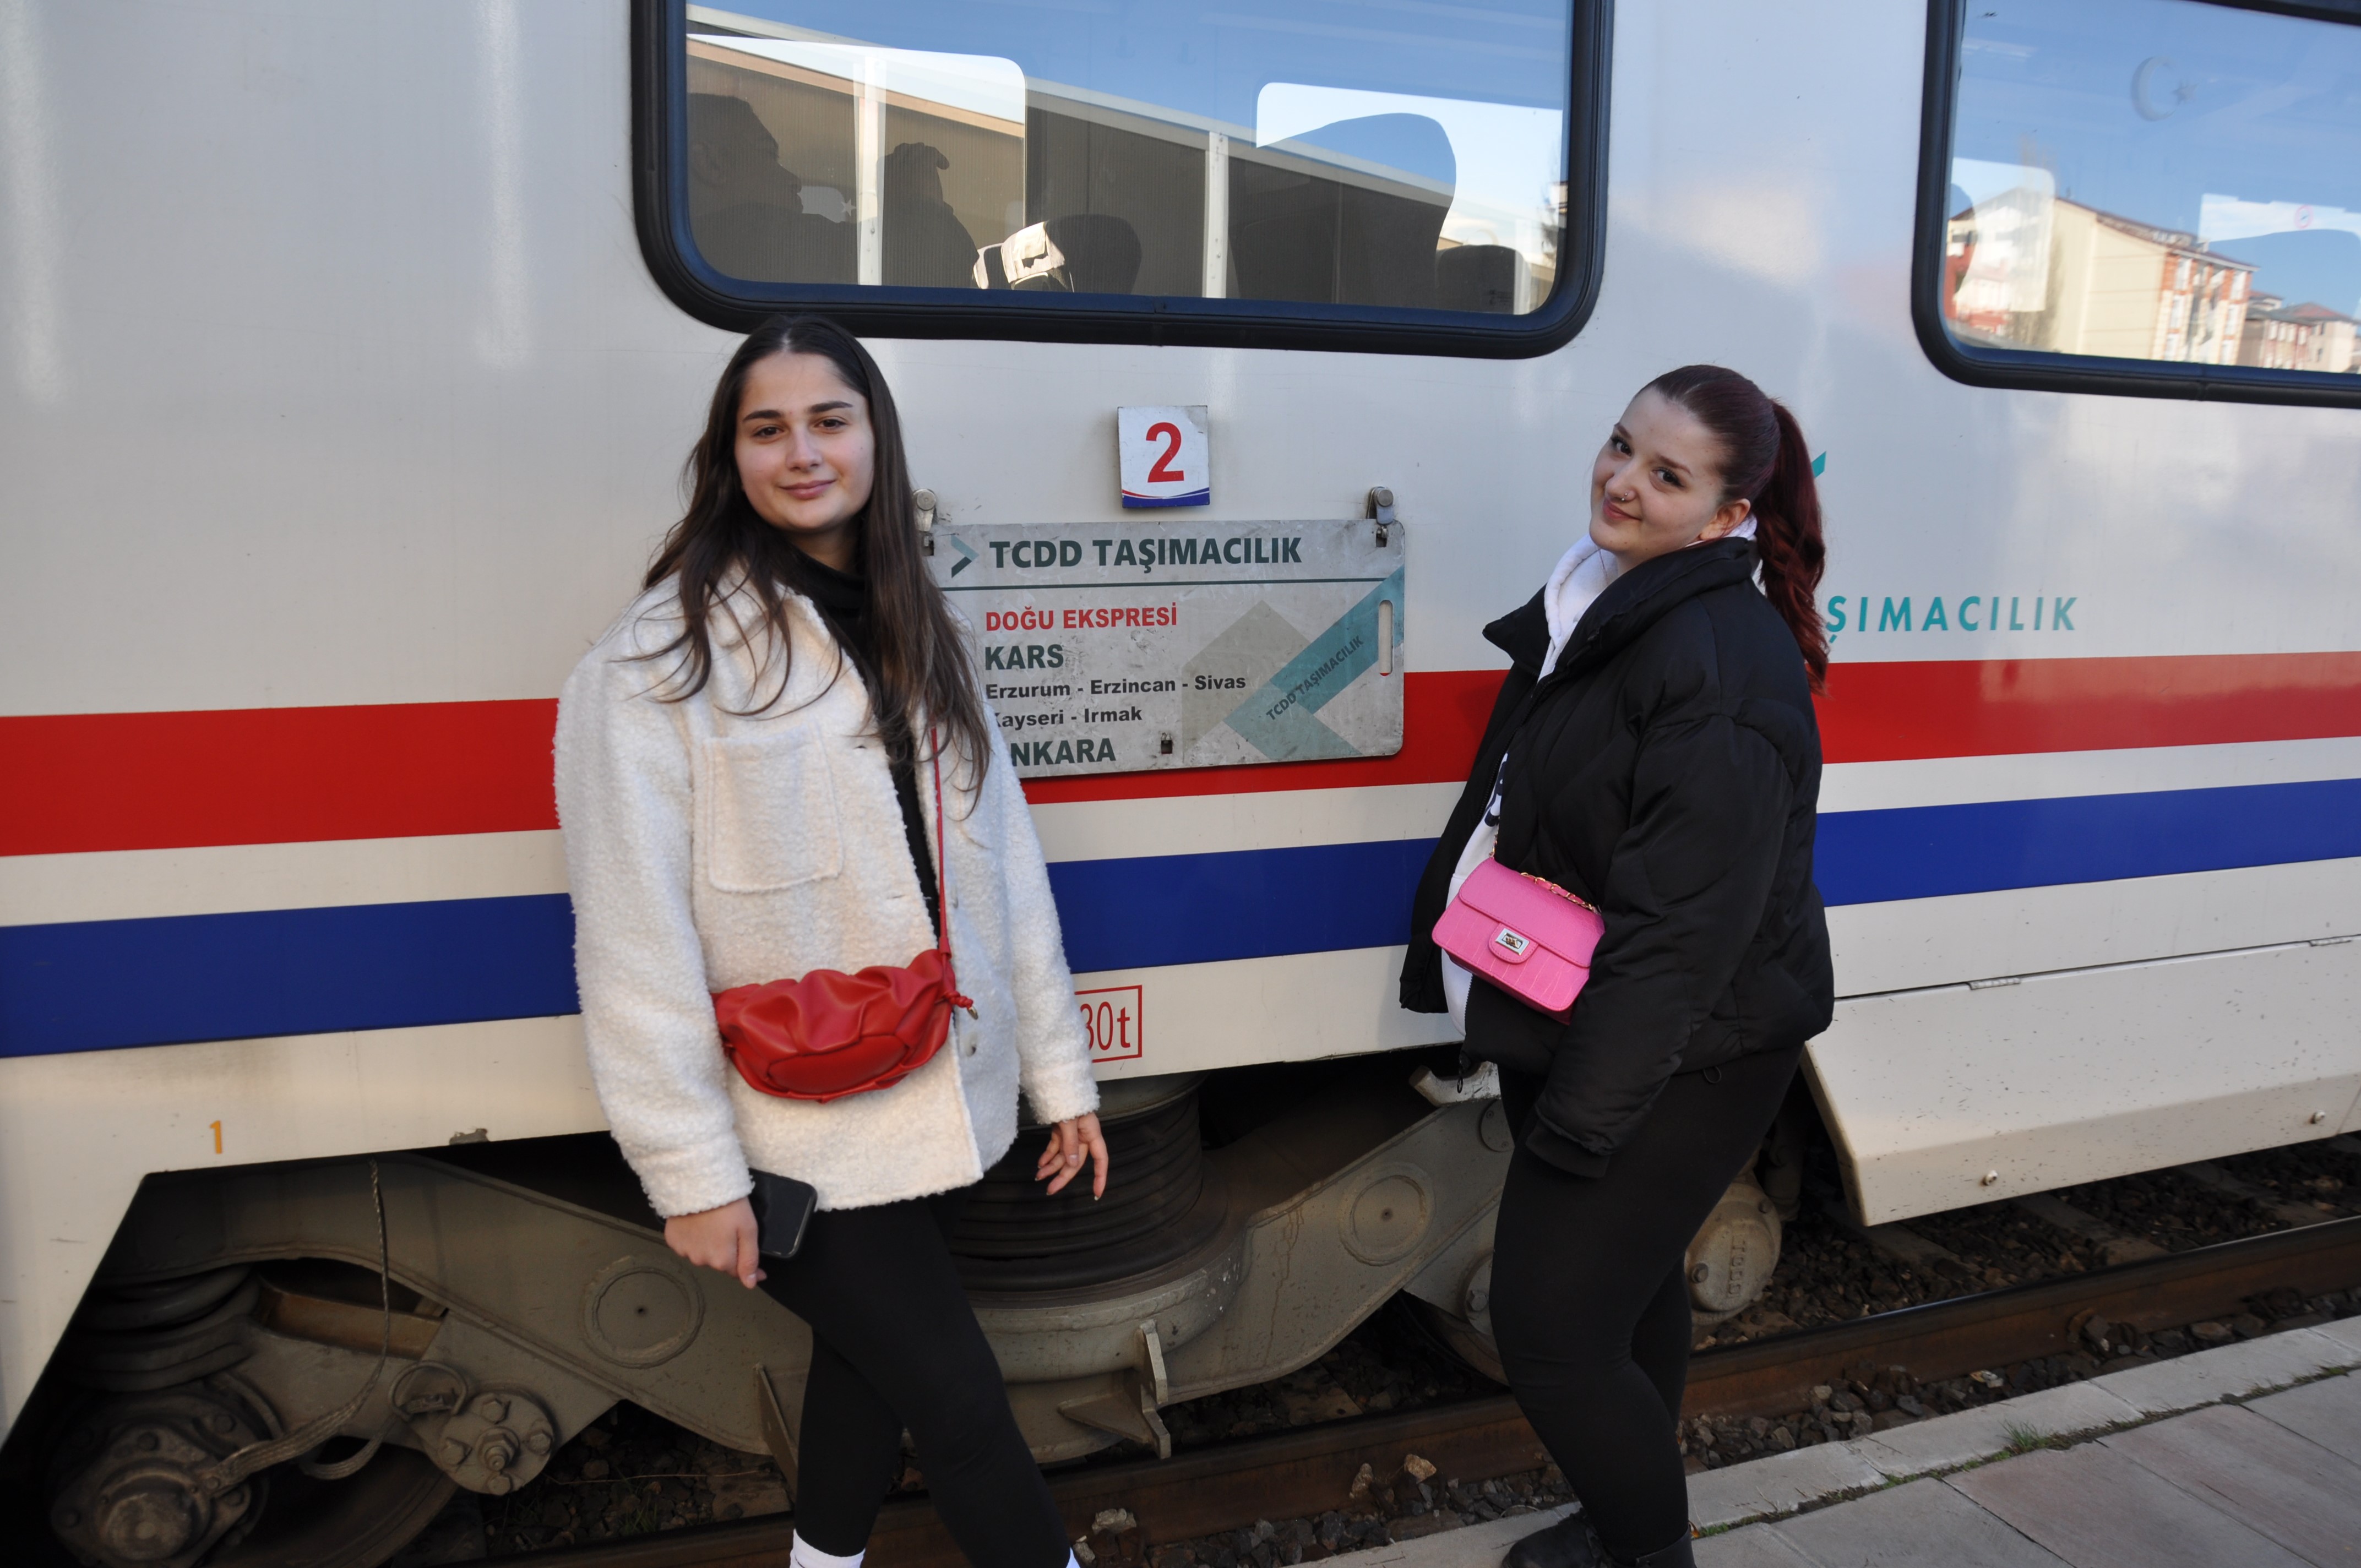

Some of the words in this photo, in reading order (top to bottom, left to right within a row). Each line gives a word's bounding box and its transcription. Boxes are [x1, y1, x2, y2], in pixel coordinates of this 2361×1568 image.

[1145, 422, 1184, 483] 2
[989, 539, 1082, 569] TCDD
[1092, 537, 1302, 574] TAŞIMACILIK
[986, 606, 1054, 631] DOĞU
[1063, 602, 1178, 629] EKSPRESİ
[1826, 595, 2078, 644] ŞIMACILIK
[984, 643, 1064, 671] KARS
[986, 684, 1070, 699] Erzurum
[1090, 678, 1176, 695] Erzincan
[1194, 674, 1247, 691] Sivas
[1265, 693, 1297, 721] TCDD
[1295, 635, 1364, 695] TAŞIMACILIK
[1084, 706, 1143, 724] Irmak
[1010, 738, 1117, 767] NKARA
[209, 1120, 222, 1154] 1
